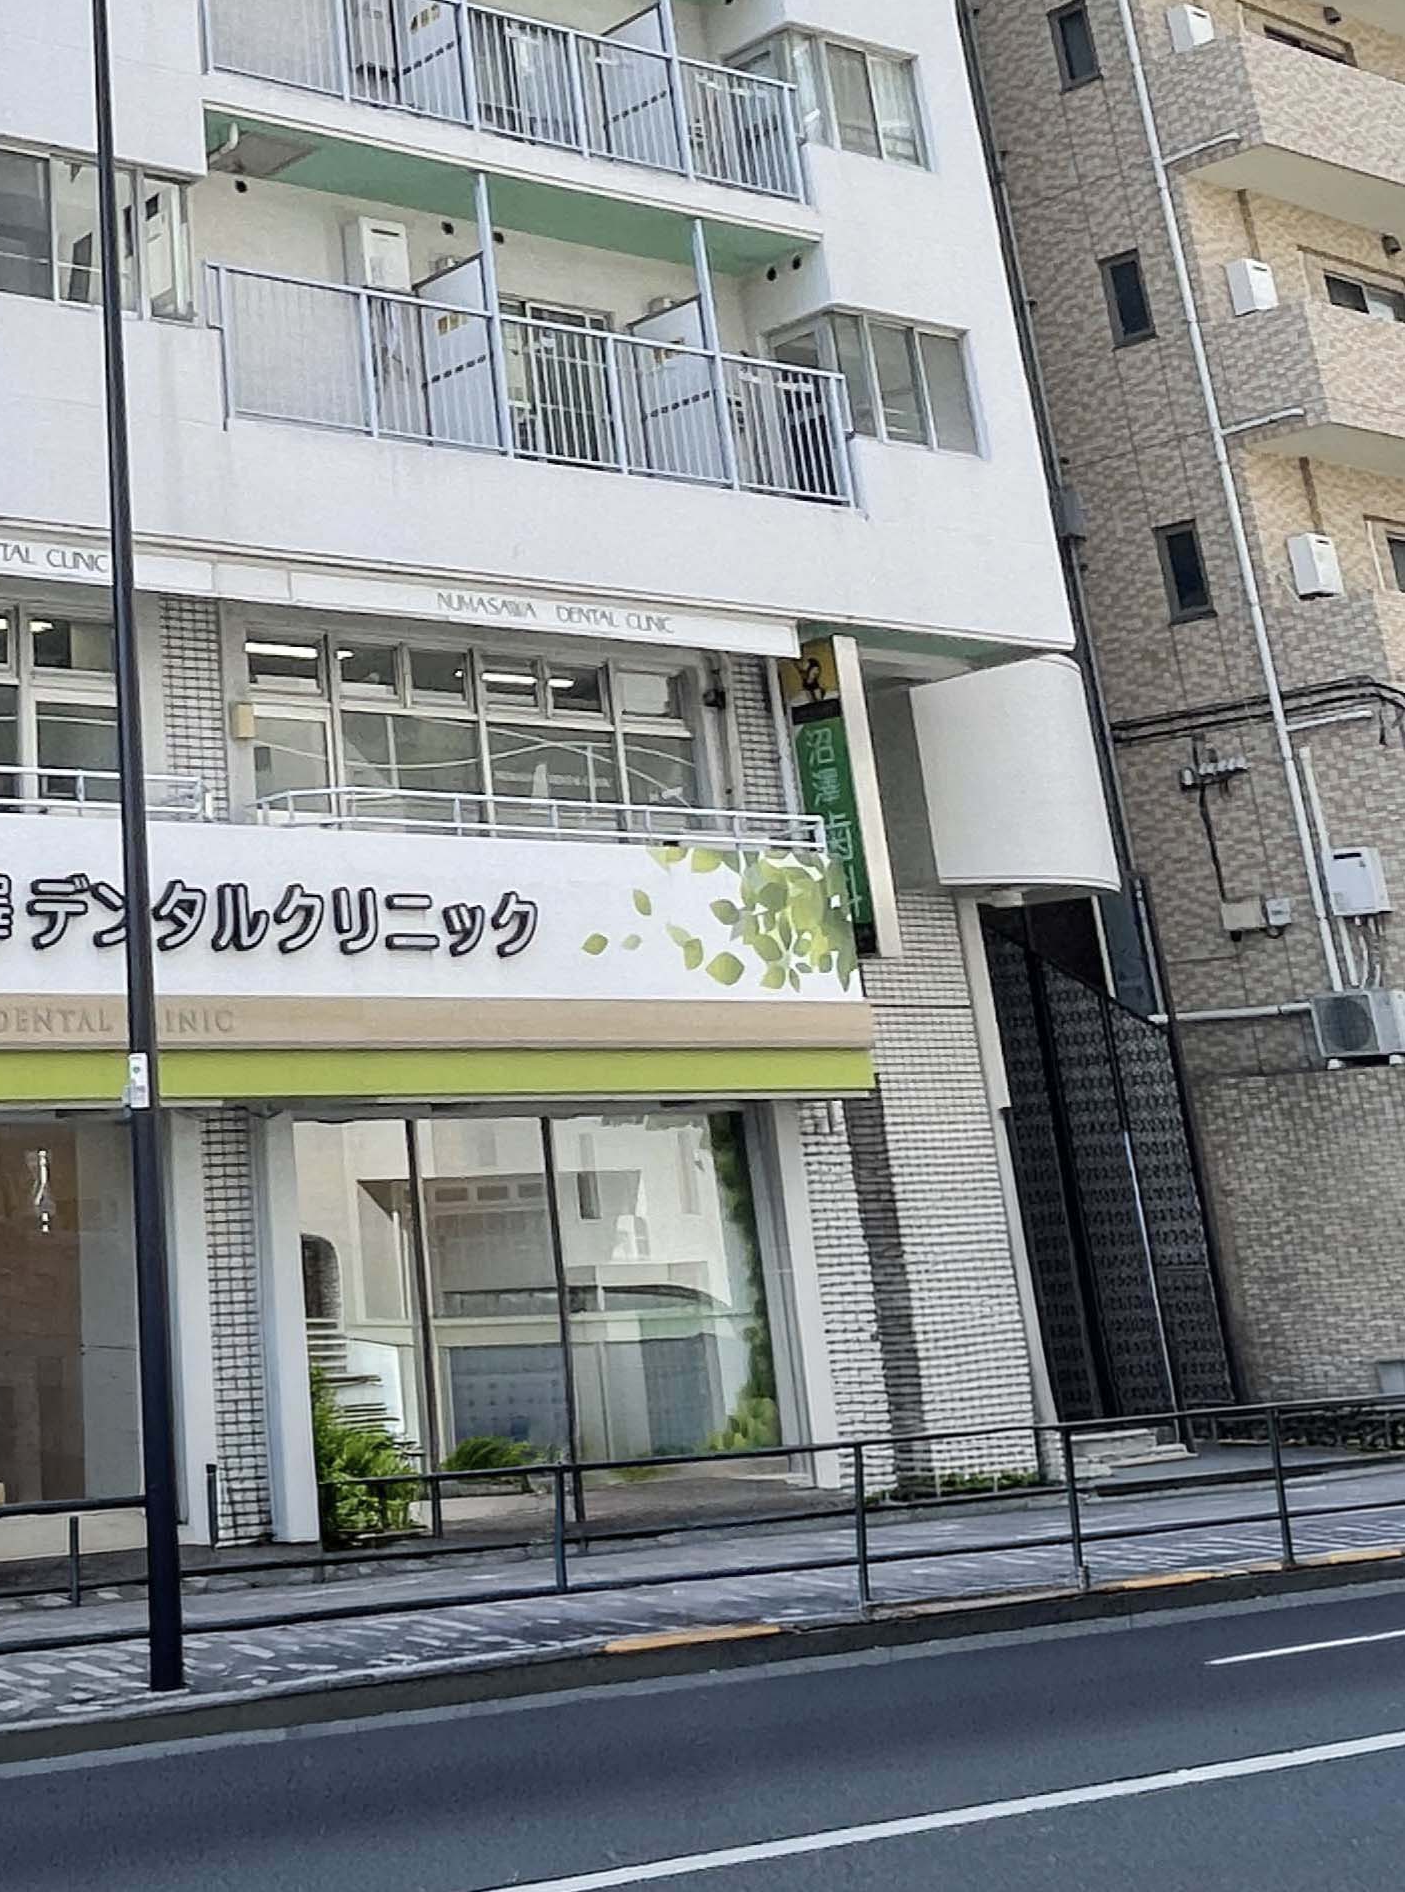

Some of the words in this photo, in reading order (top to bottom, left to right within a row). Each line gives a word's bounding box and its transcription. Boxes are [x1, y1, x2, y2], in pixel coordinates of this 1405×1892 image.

[47, 548, 108, 573] CLINIC
[437, 592, 537, 619] NUMASAWA
[556, 605, 620, 628] DENTAL
[163, 1008, 235, 1034] INIC
